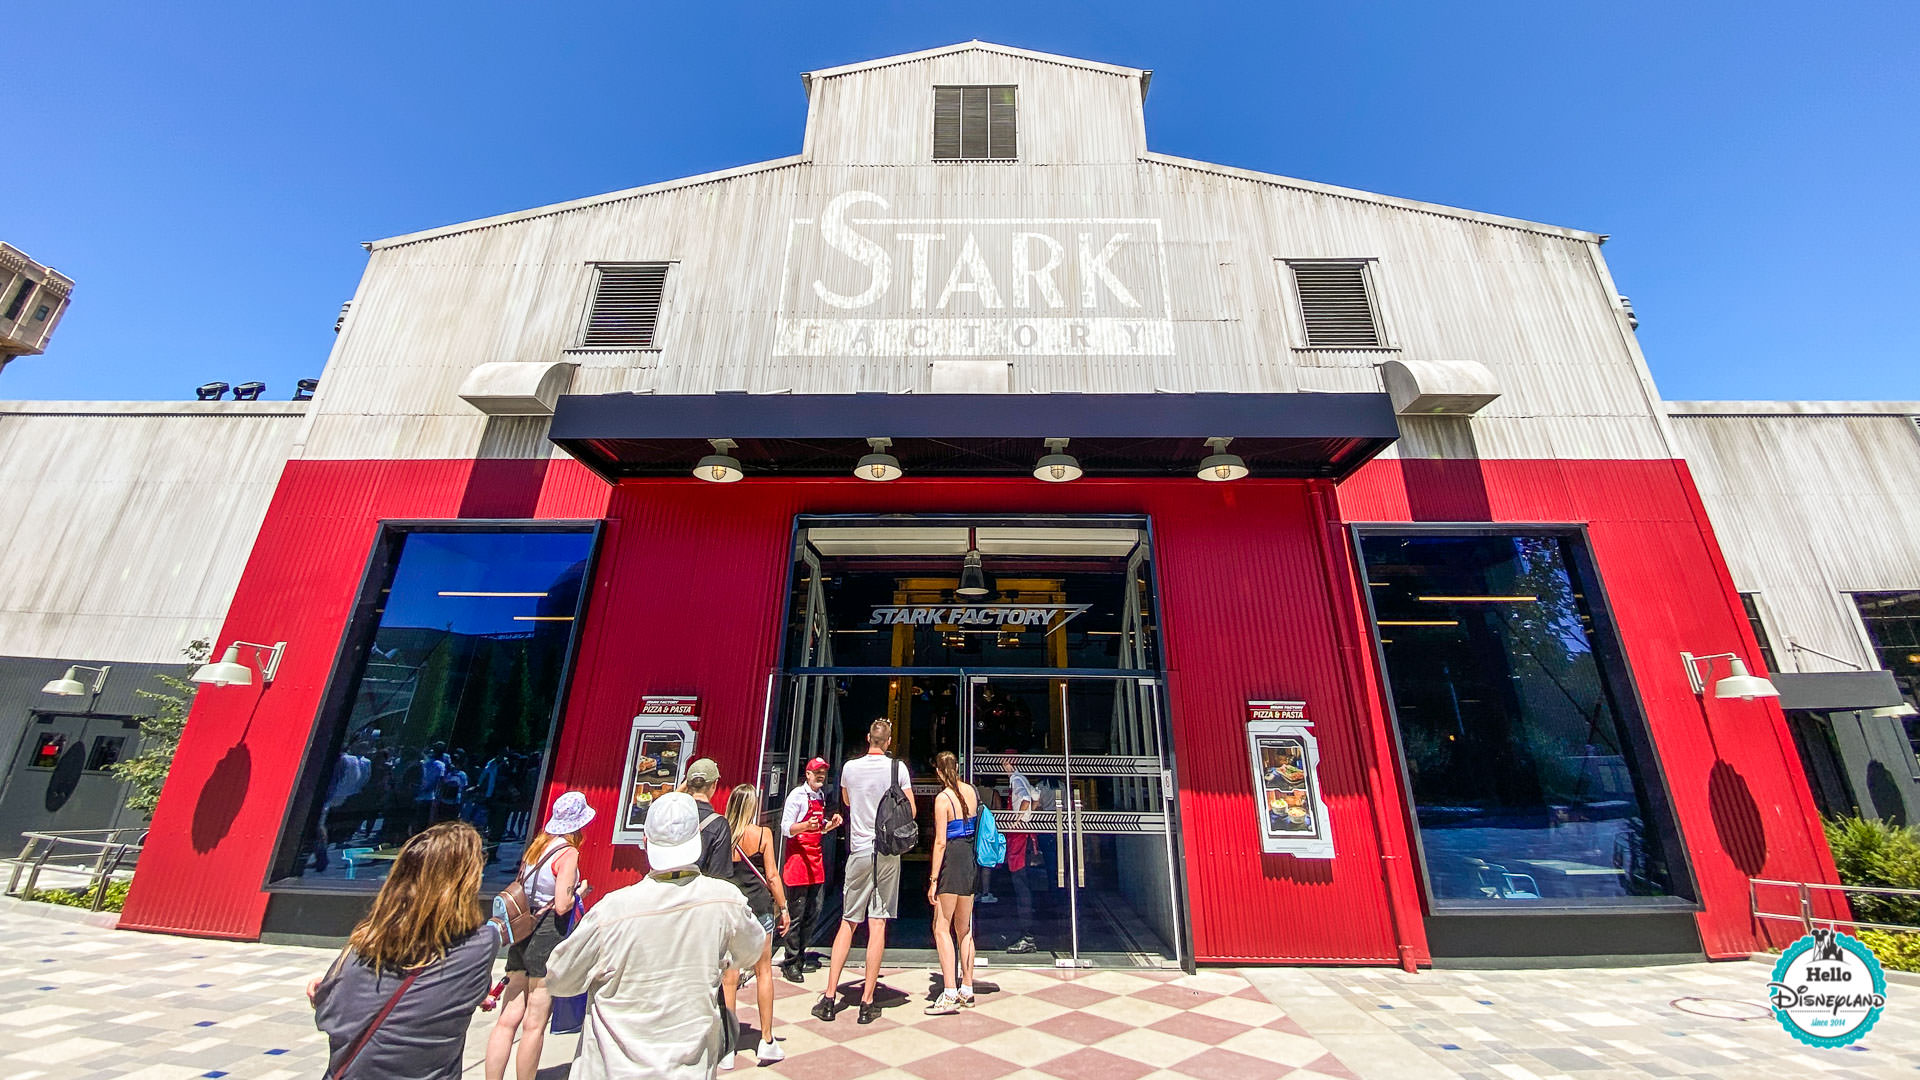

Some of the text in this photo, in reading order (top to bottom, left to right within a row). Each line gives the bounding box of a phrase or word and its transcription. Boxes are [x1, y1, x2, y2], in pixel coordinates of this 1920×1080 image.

[803, 325, 1146, 348] FACTORY
[869, 609, 1058, 625] STARK FACTORY
